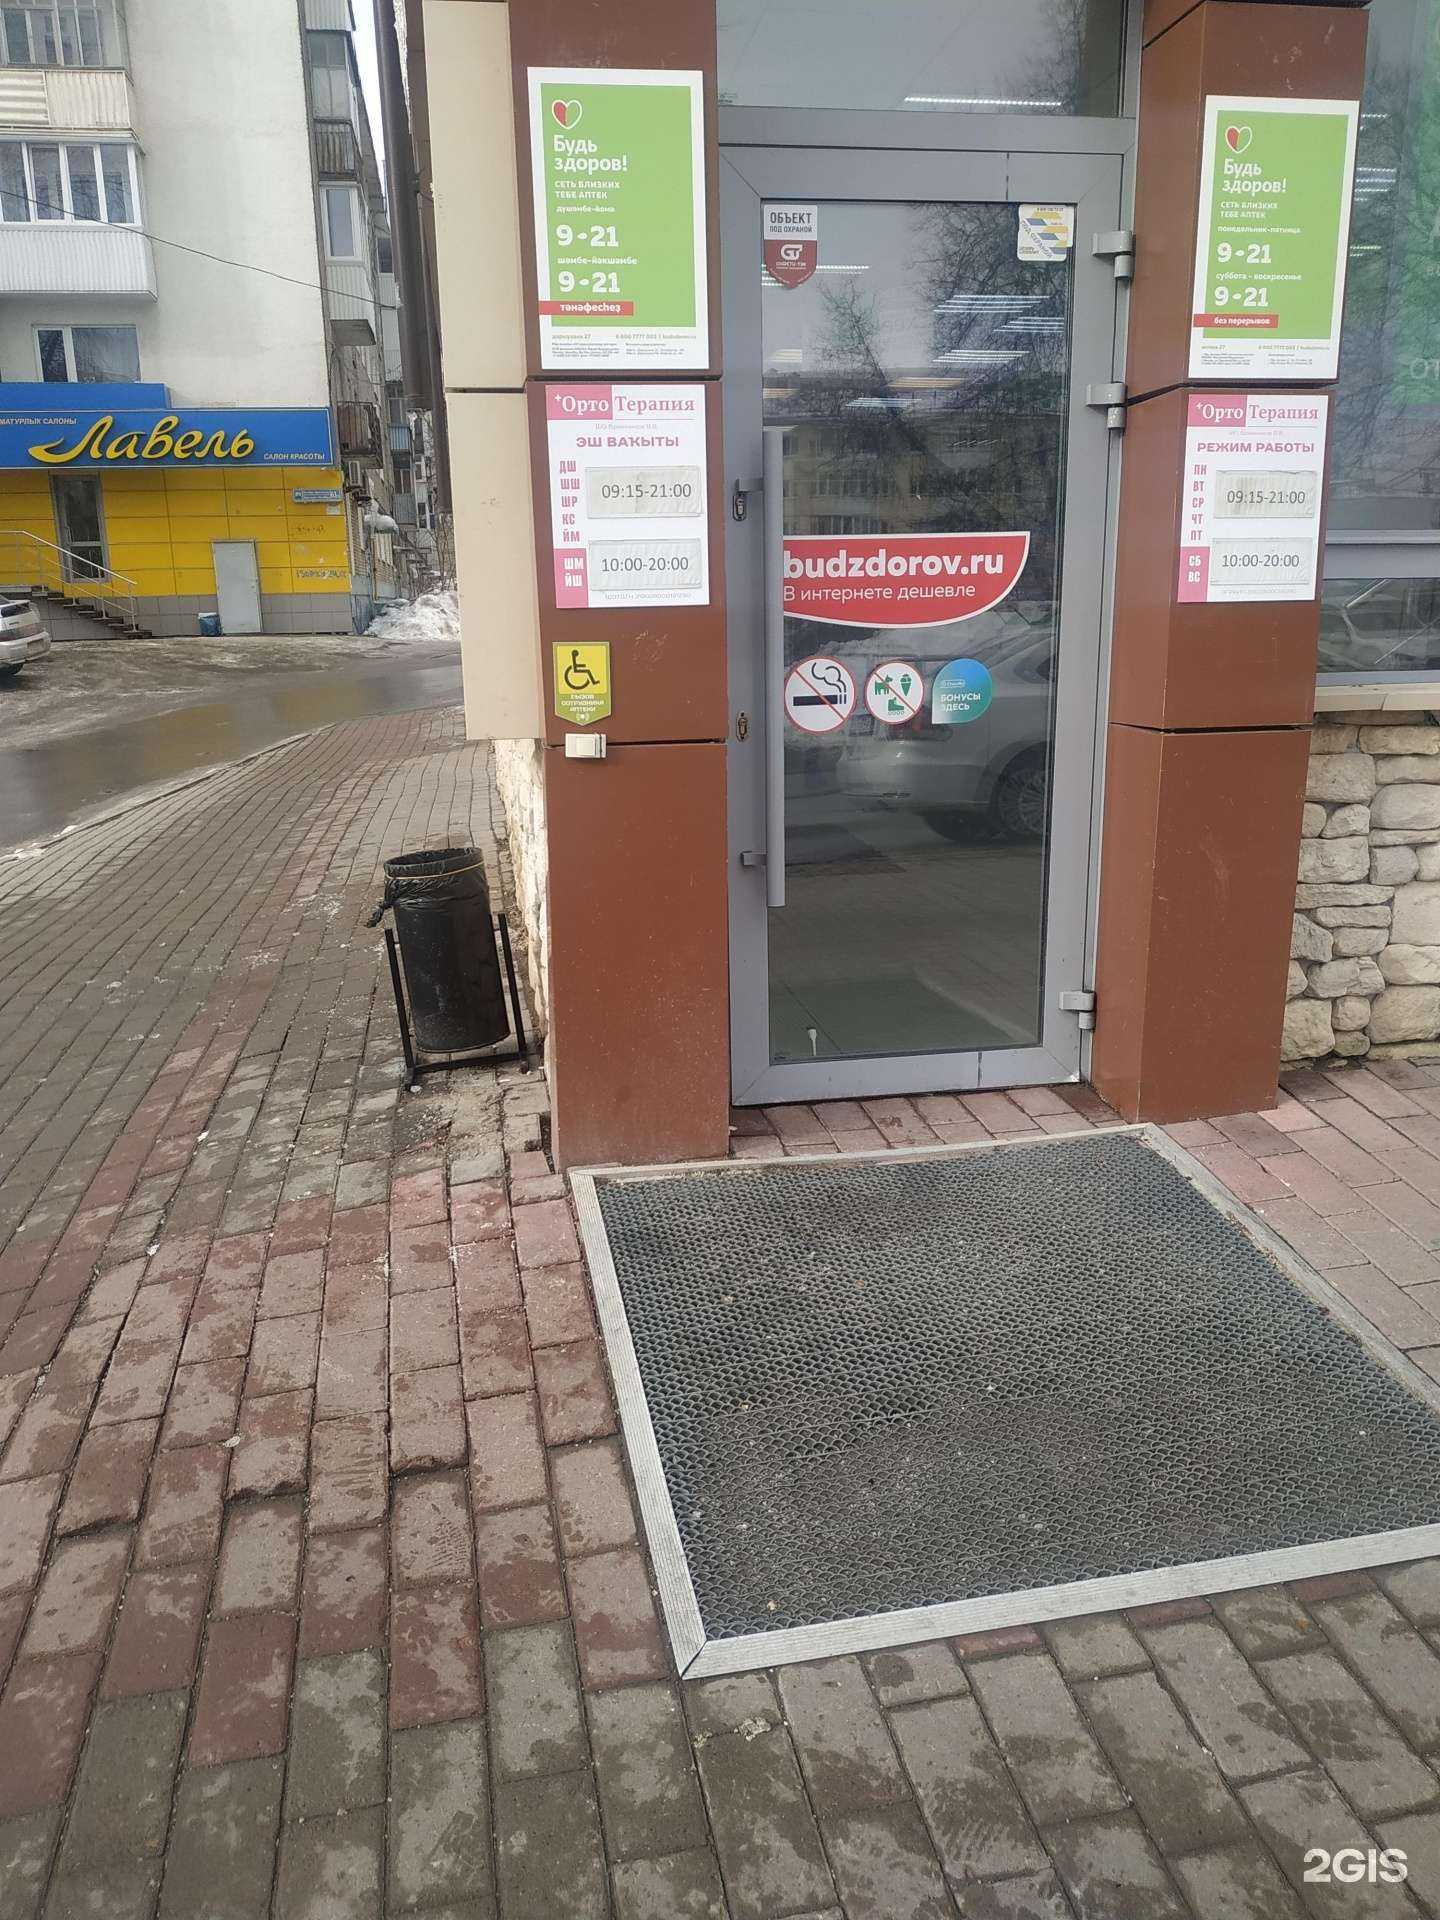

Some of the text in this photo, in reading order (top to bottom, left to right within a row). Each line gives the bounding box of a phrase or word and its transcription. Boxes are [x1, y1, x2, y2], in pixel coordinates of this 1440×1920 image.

[553, 134, 598, 156] Будь
[553, 155, 628, 175] здоров!
[1223, 158, 1262, 178] Будь
[554, 180, 620, 189] СЕТЬ БЛИЗКИХ
[1222, 178, 1287, 196] здоров!
[555, 190, 608, 199] ТЕБЕ АПТЕК
[1220, 201, 1239, 209] СЕТЬ
[769, 211, 812, 224] ОБЪЕКТ
[769, 225, 812, 233] ПОД ОХРАНОЙ
[1214, 317, 1227, 325] без
[561, 395, 695, 416] Орто Терапия
[1202, 403, 1319, 422] Орто Терапия
[28, 415, 256, 462] Лавель
[576, 436, 602, 448] ЭШ
[1197, 442, 1315, 453] РЕЖИМ РАБОТЫ
[559, 460, 577, 474] ДШ
[1193, 464, 1207, 476] ПН
[560, 477, 580, 490] ШШ
[1192, 481, 1204, 492] ВТ
[601, 483, 692, 499] 09:15-21:00
[1226, 490, 1306, 504] 09:15-21:00
[561, 495, 578, 508] ШР
[1191, 497, 1205, 508] СР
[562, 513, 576, 525] КС
[1191, 513, 1204, 525] ЧТ
[563, 529, 580, 543] ЙМ
[1190, 530, 1202, 541] ПТ
[563, 557, 584, 570] ШМ
[601, 556, 689, 572] 10:00-20:00
[783, 548, 1004, 579] budzdorov.ru
[1188, 555, 1201, 567] СБ
[1221, 554, 1300, 568] 10:00-20:00
[1187, 571, 1201, 583] ВС
[783, 583, 976, 605] В интернете дешевле
[940, 692, 981, 702] БОНУСЫ
[941, 703, 970, 713] ЗДЕСЬ
